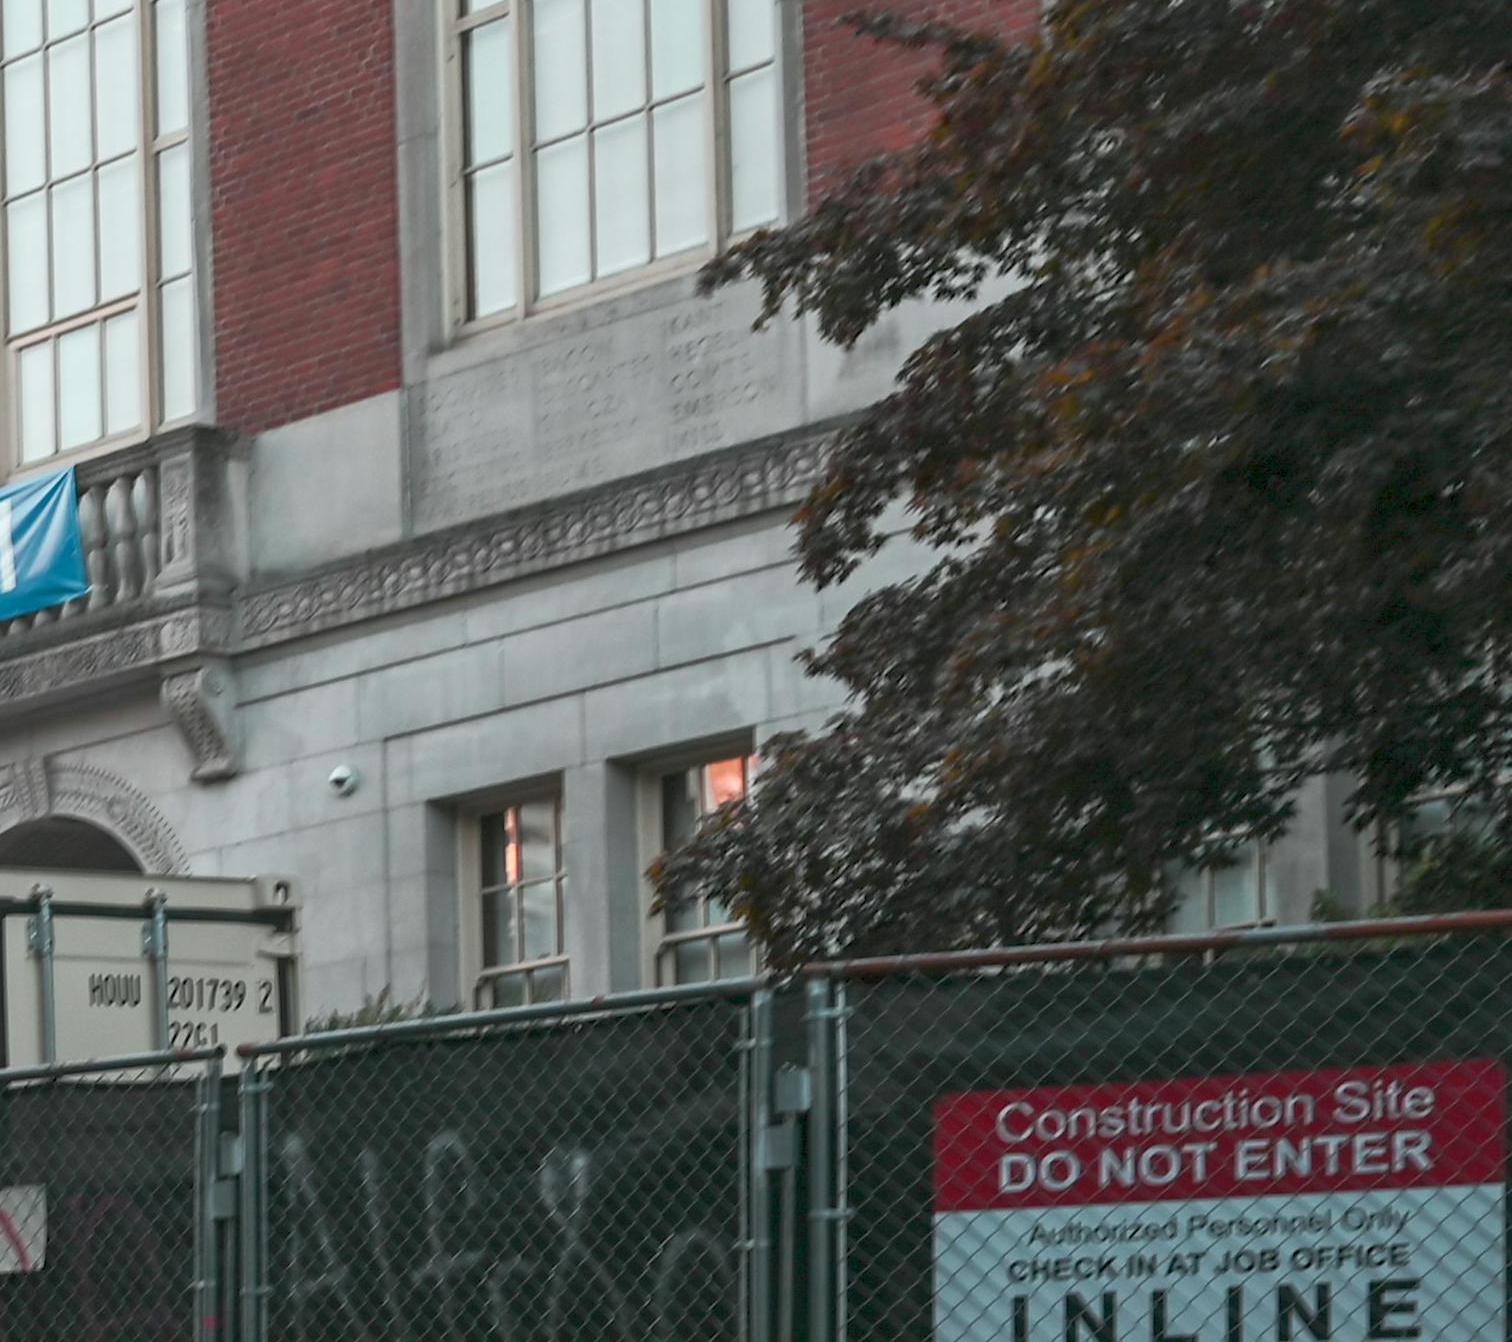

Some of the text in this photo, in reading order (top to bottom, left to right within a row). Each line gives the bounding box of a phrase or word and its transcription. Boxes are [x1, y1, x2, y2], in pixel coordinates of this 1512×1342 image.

[87, 973, 274, 1014] HOUU 201739 2
[995, 1078, 1436, 1145] Construction Site
[1000, 1130, 1436, 1194] DO NOT ENTER
[1028, 1205, 1411, 1247] Authorized Personnel Only
[1008, 1242, 1413, 1284] CHECK IN AT JOB OFFICE
